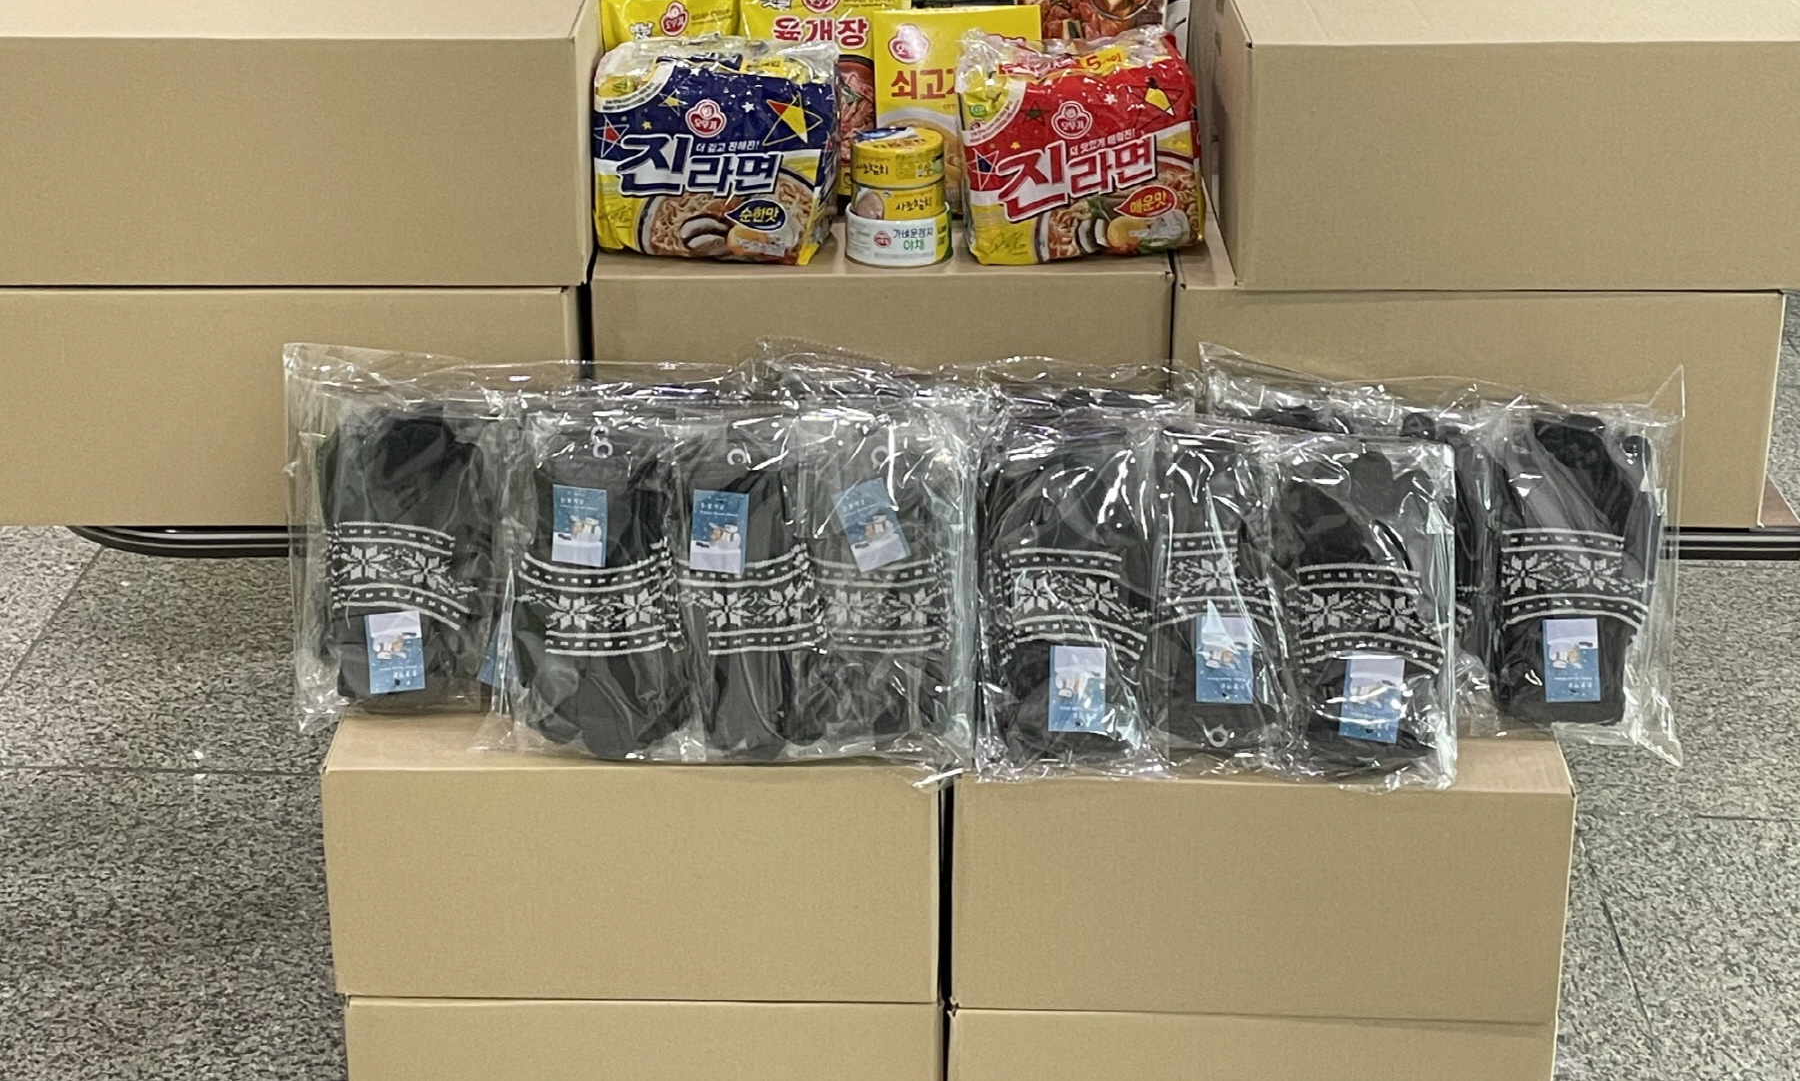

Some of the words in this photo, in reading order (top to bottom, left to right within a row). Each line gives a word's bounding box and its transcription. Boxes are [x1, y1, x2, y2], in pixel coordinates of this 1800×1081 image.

[773, 17, 869, 48] 육개장
[616, 133, 784, 197] 진라면
[995, 134, 1157, 223] 진라면
[739, 207, 780, 223] 순한맛
[1129, 191, 1168, 214] 매운맛
[903, 239, 925, 252] 야채
